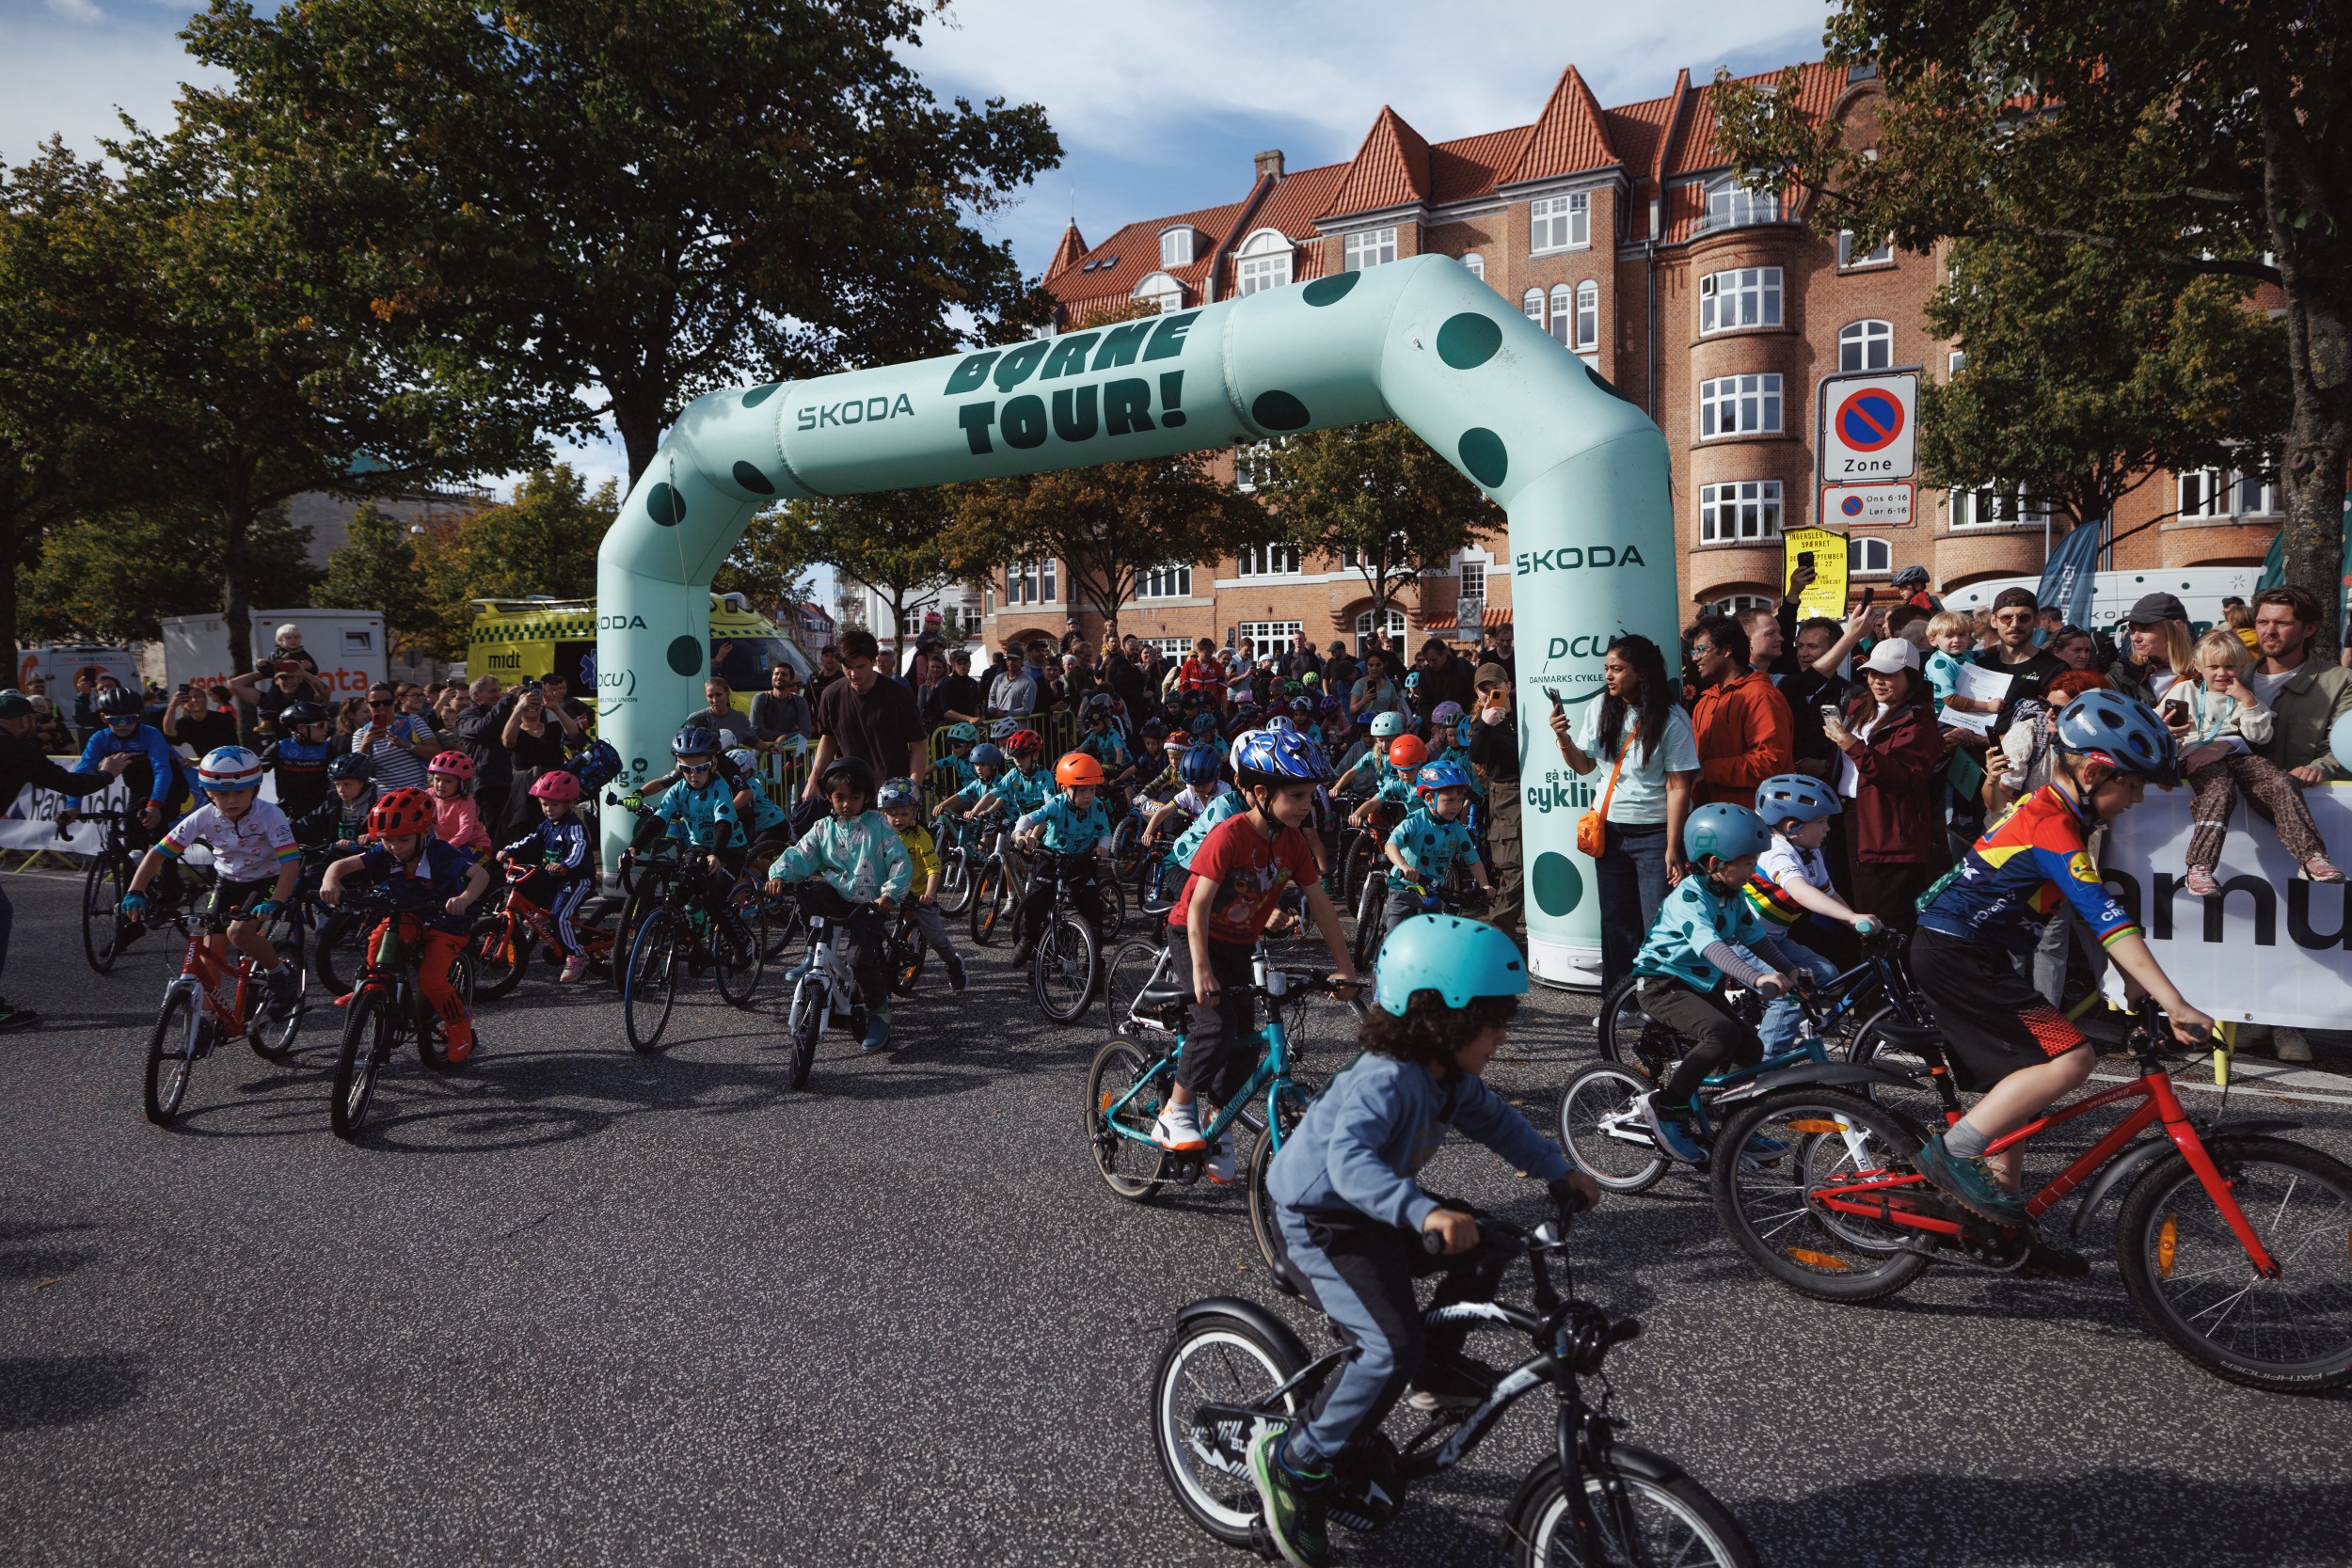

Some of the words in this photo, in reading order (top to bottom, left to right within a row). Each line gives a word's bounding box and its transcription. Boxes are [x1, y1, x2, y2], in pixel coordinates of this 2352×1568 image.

[959, 369, 1186, 455] TOUR!
[1844, 459, 1892, 472] Zone
[1789, 531, 1823, 541] INGERSLEV
[1802, 540, 1830, 548] SPÆRRET
[487, 650, 521, 669] midt
[1529, 673, 1573, 684] DANMARKS
[1575, 673, 1604, 683] CYKLE
[1546, 768, 1559, 784] gå
[1563, 769, 1578, 781] til
[2219, 1359, 2323, 1382] PATHFINDER
